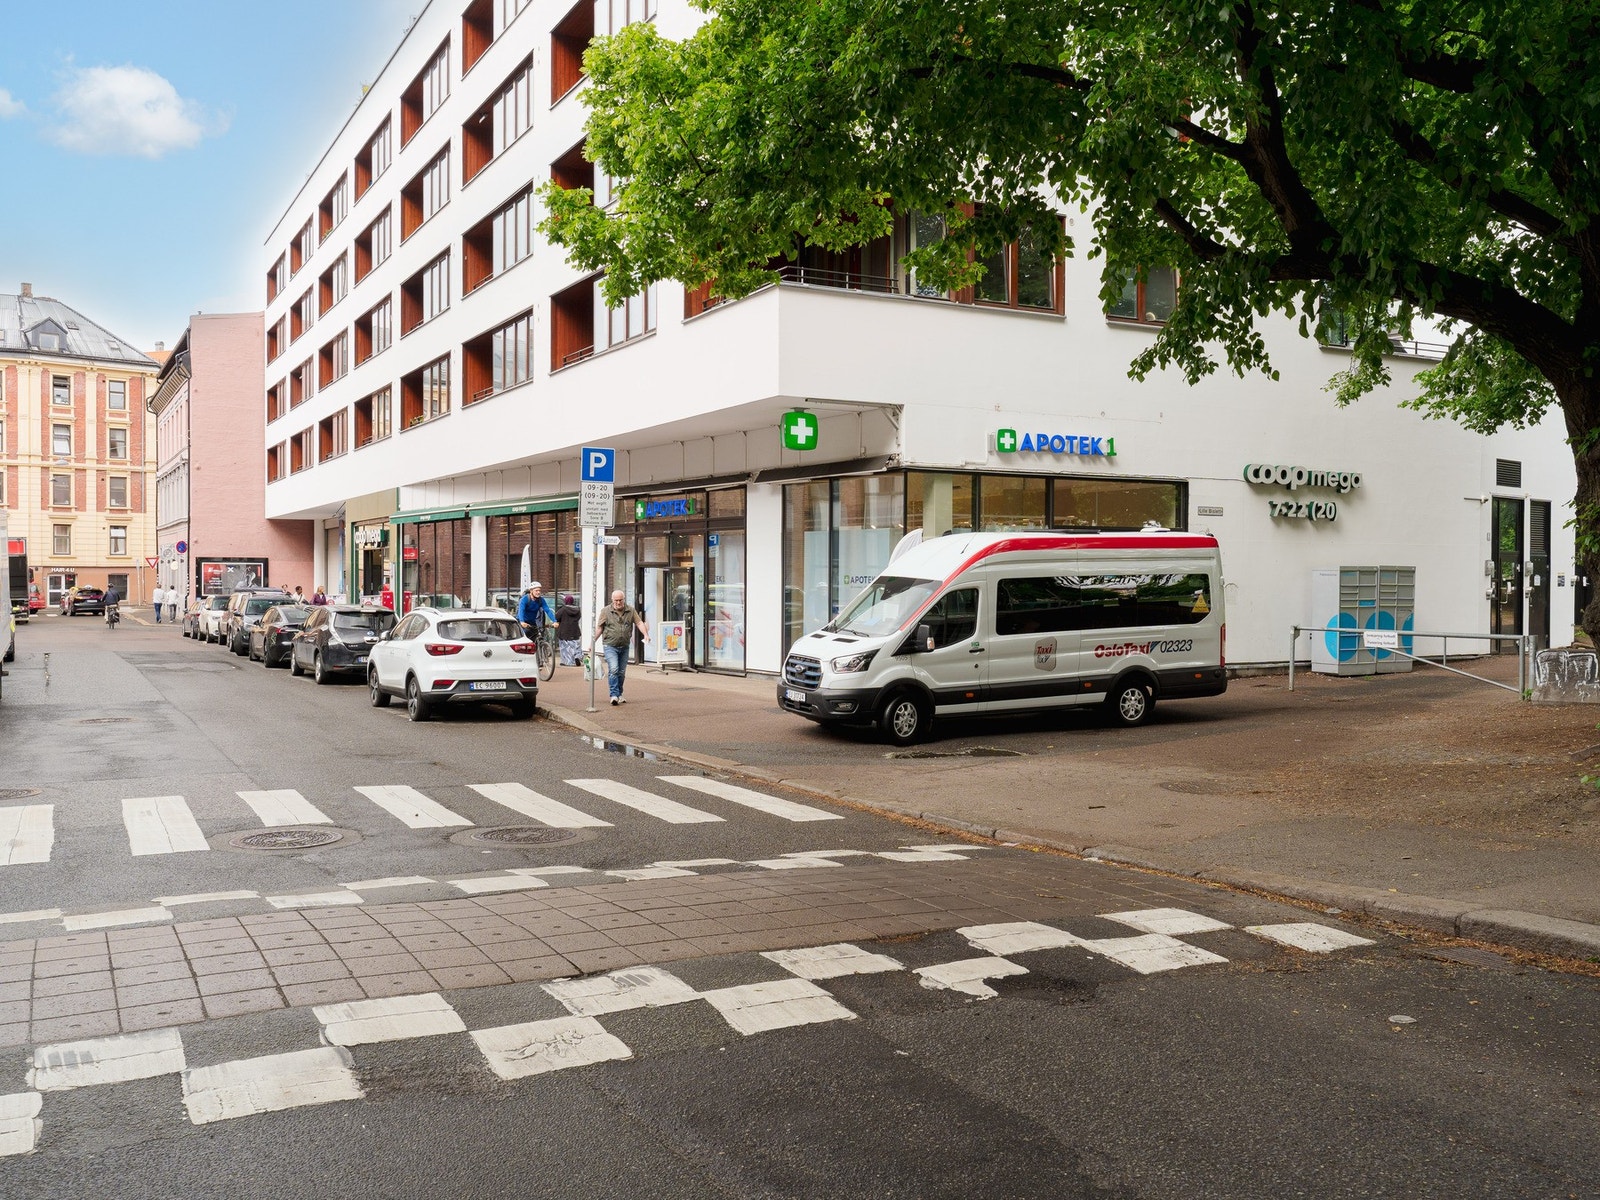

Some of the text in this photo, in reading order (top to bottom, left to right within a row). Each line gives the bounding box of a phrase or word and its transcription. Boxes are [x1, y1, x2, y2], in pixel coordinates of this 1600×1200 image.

[1020, 432, 1104, 456] APOTEK
[589, 452, 607, 478] P
[1243, 463, 1363, 494] coop mega
[646, 499, 687, 518] APOTEK
[1307, 500, 1338, 522] (20)
[1036, 643, 1053, 655] Taxi
[1094, 639, 1193, 658] OsloTaxi 02323
